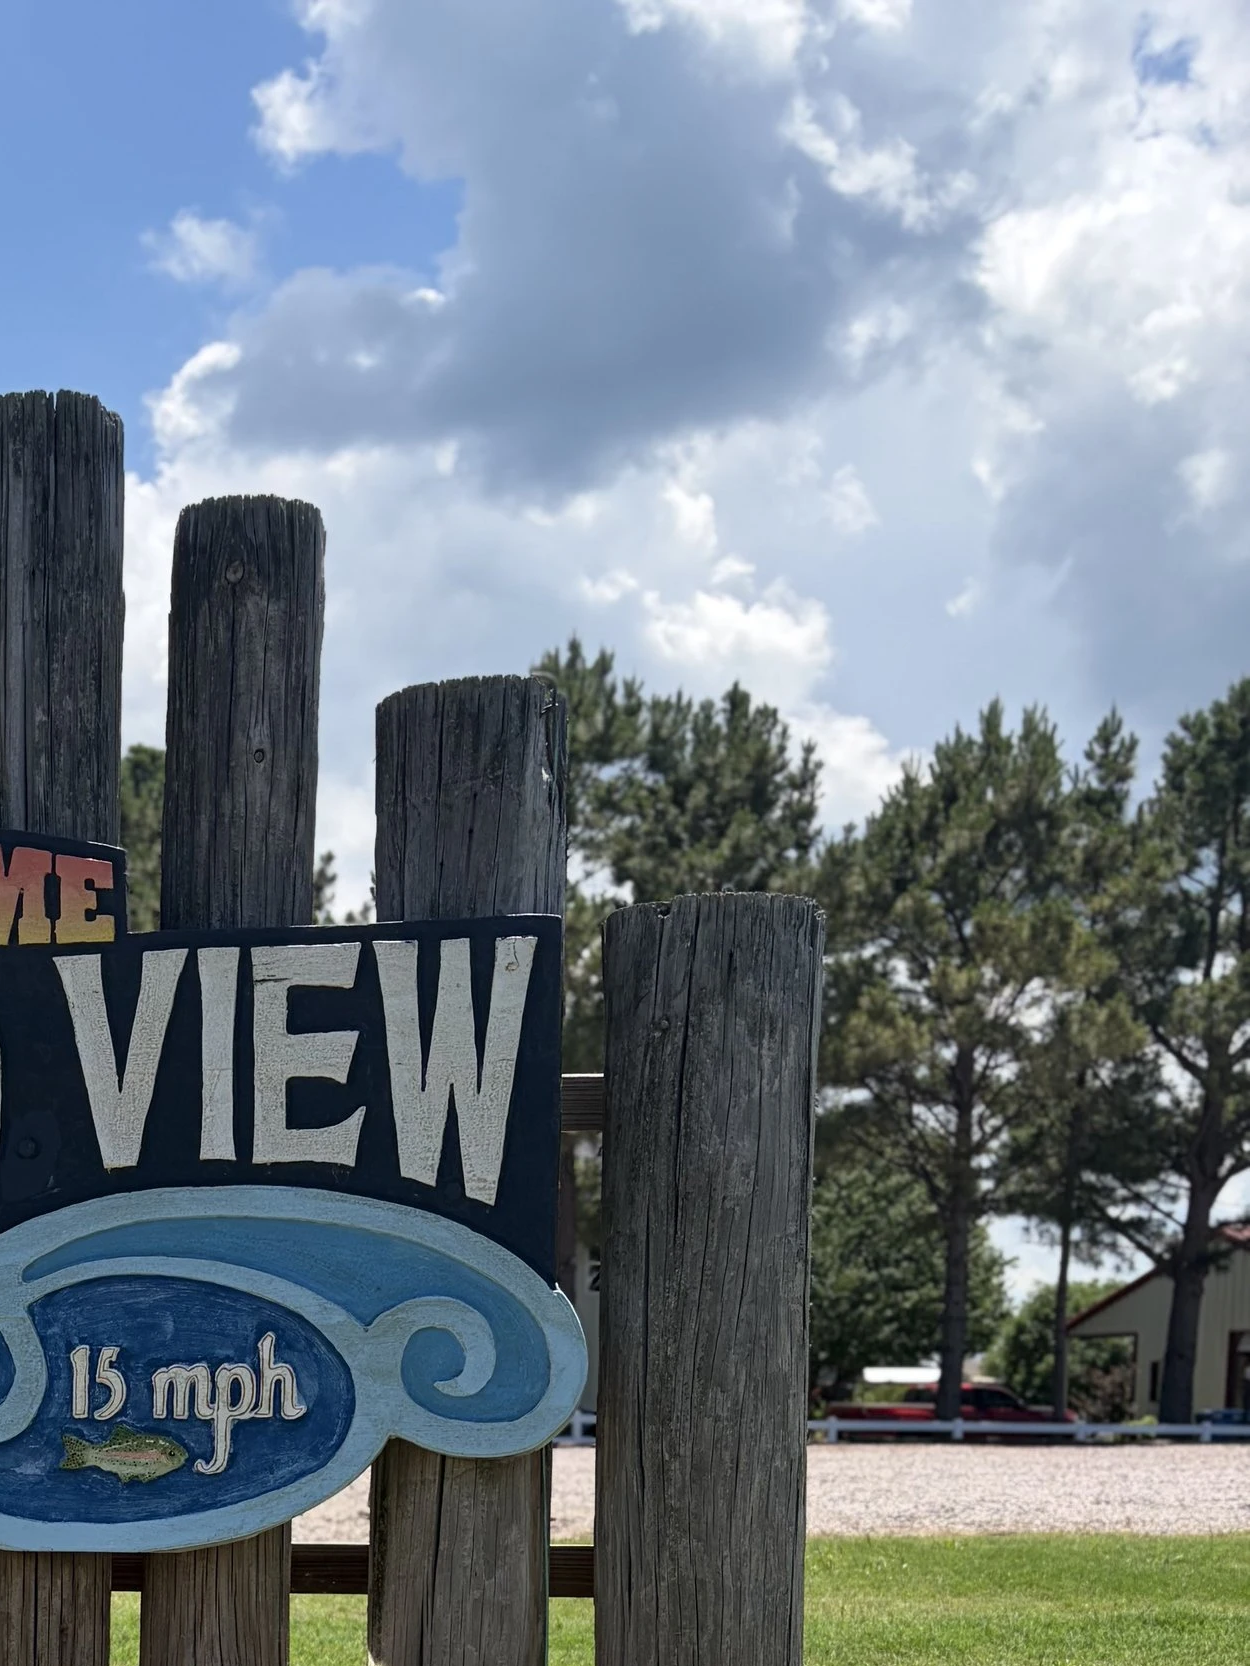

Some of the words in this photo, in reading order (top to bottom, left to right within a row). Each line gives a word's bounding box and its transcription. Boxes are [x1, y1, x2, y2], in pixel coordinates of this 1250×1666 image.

[53, 936, 538, 1206] VIEW
[70, 1345, 127, 1421] 15
[152, 1332, 306, 1475] mph
